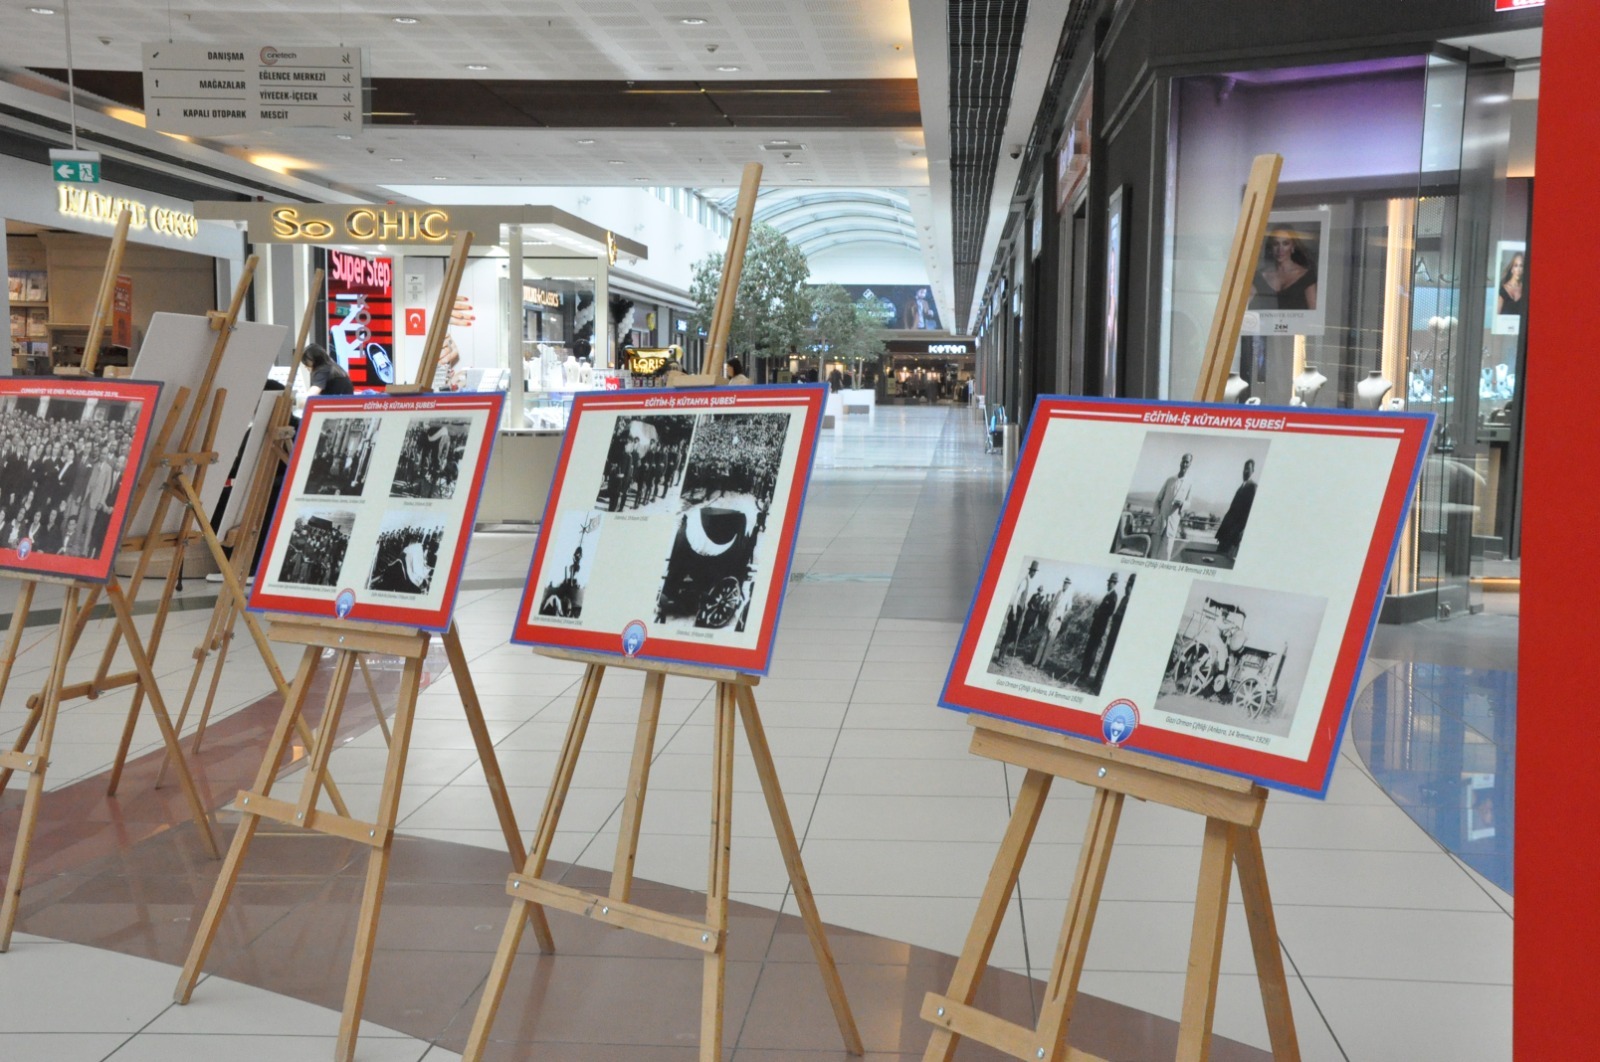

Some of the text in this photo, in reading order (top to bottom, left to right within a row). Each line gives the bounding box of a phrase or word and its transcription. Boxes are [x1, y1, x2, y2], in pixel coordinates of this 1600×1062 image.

[207, 52, 244, 62] DANIŞMA
[259, 70, 326, 82] EĞLENCE MERKEZİ
[199, 79, 246, 90] MAĞAZALAR
[260, 91, 318, 102] YİYECEK-İÇECEK
[183, 109, 247, 119] KAPALI OTOPARK
[260, 109, 289, 120] MESCİT
[150, 206, 198, 238] COCO
[271, 207, 449, 241] So CHIC
[389, 400, 415, 409] KÜTAHYA
[415, 399, 437, 410] ŞUBESİ
[644, 395, 737, 408] EĞİTİM-İŞ KÜTAHYA ŞUBESİ
[1143, 410, 1286, 431] EĞİTİM-İŞ KÜTAHYA ŞUBESİ
[1185, 565, 1202, 574] Temmuz
[1176, 718, 1191, 727] Orman
[1236, 731, 1254, 741] Temmuz
